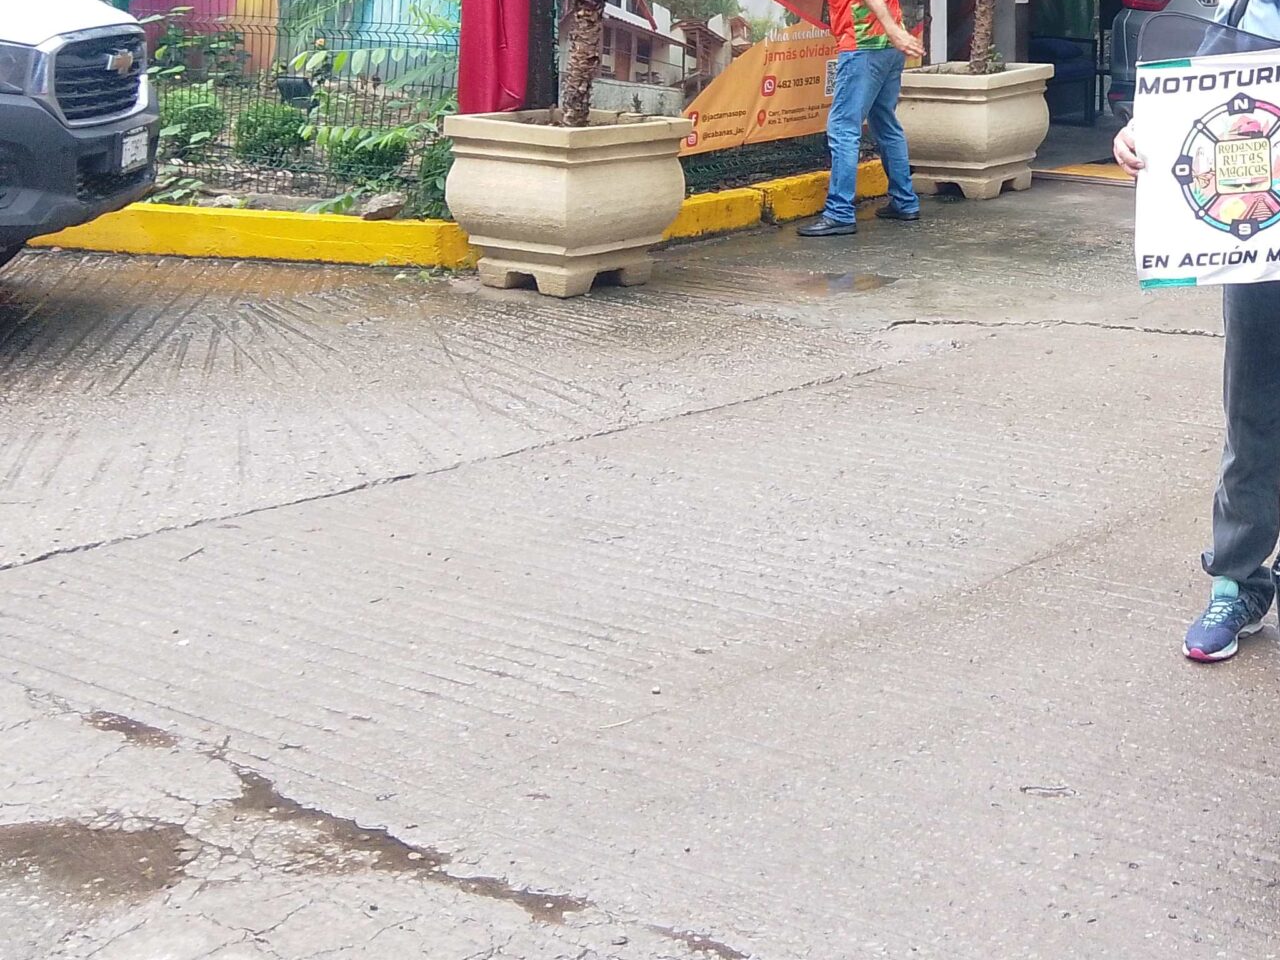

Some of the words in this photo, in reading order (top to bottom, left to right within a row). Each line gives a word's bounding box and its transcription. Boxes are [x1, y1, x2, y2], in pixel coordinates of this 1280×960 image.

[764, 48, 798, 66] jamás
[1233, 99, 1249, 110] N
[1239, 224, 1251, 235] S
[1142, 254, 1169, 270] EN
[1178, 245, 1258, 268] ACCIÓN
